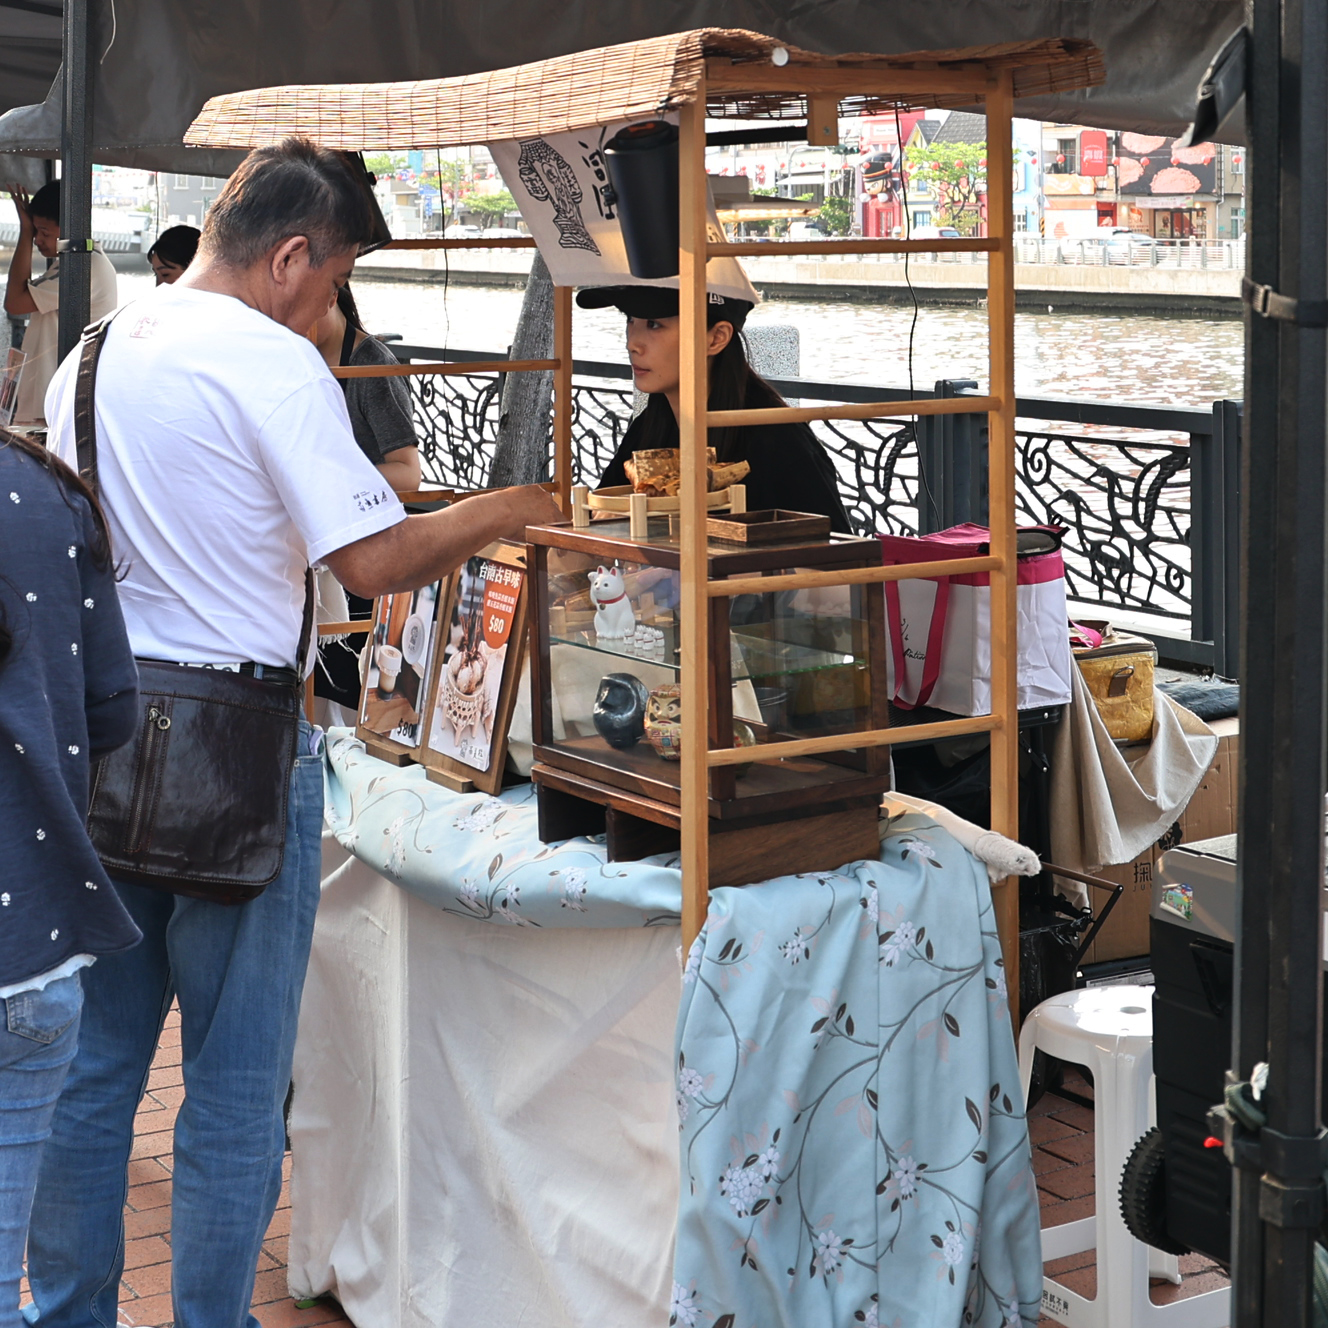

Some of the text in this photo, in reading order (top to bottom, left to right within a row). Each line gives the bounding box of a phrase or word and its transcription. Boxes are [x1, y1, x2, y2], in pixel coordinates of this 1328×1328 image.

[479, 561, 521, 589] 台南古早味
[488, 614, 505, 634] $80
[397, 717, 414, 739] $80
